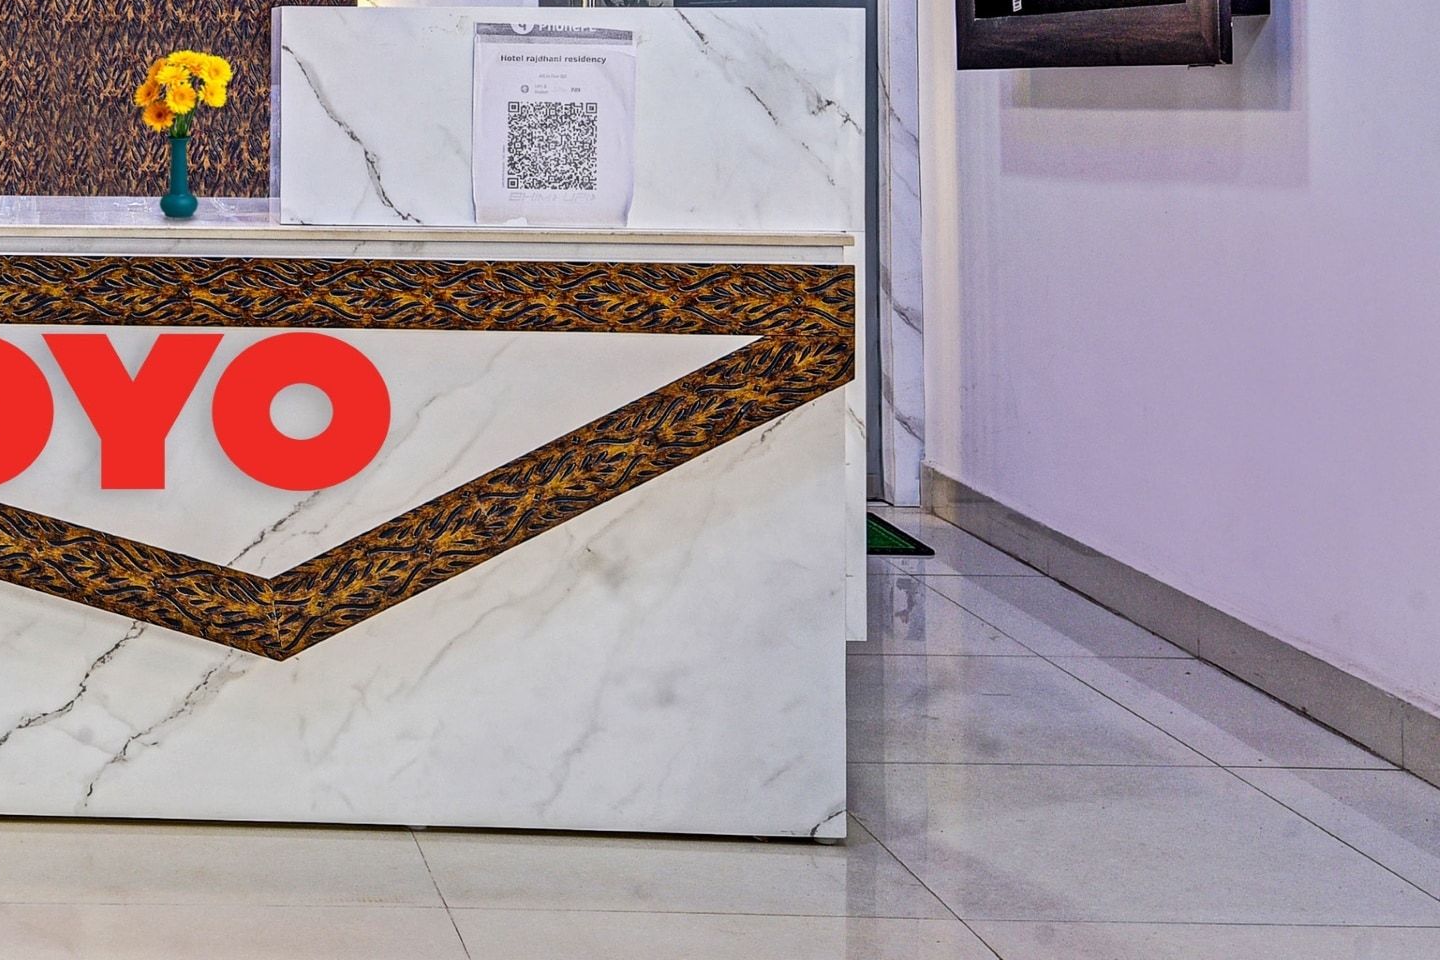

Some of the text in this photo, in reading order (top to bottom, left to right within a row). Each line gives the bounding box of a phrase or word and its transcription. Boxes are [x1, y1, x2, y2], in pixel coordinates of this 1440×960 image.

[500, 54, 607, 65] Hotel rajdhani residency
